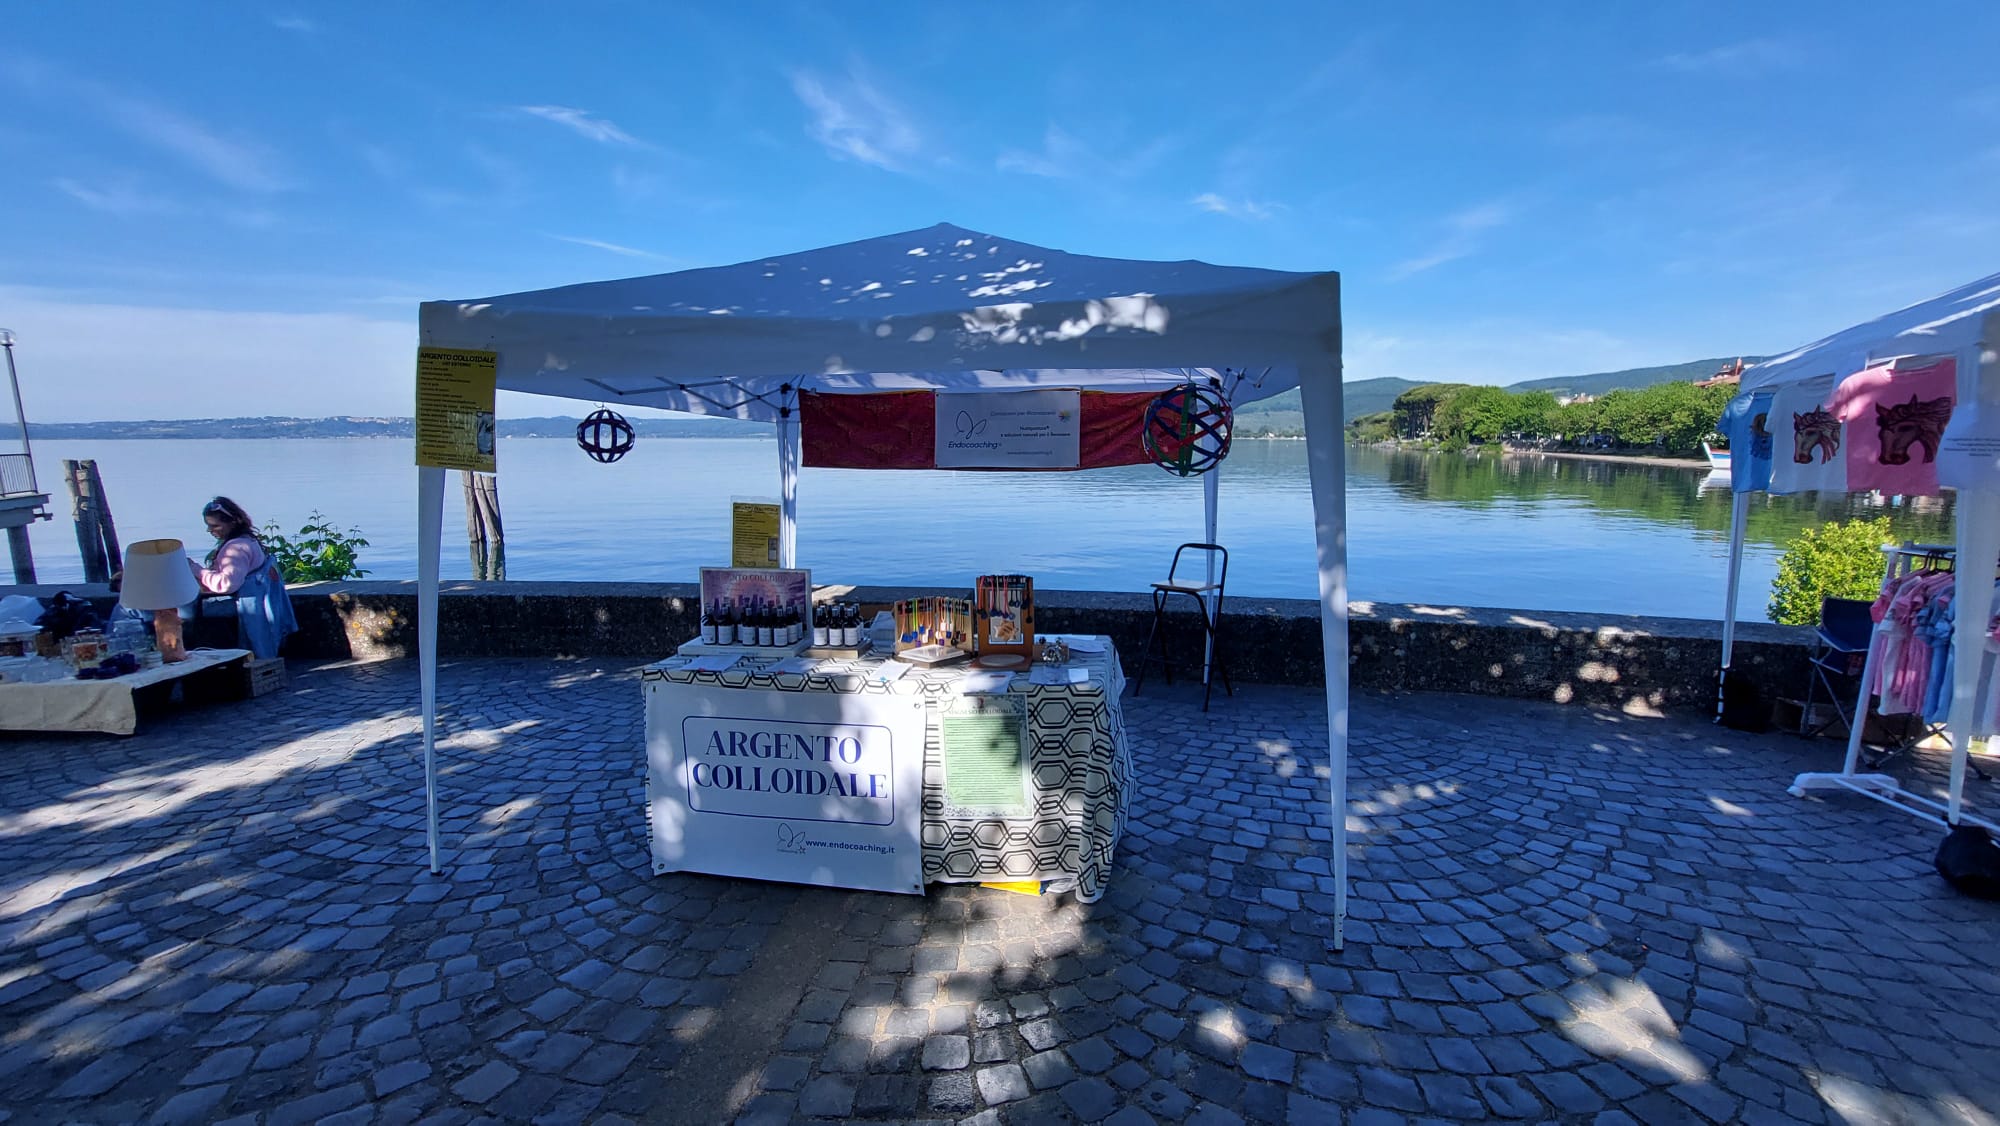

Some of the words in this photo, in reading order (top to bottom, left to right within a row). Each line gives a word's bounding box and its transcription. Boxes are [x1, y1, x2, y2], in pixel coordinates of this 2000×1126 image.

[420, 352, 452, 360] ARGENTO
[452, 354, 495, 363] COLLOIDALE
[705, 730, 862, 764] ARGENTO
[692, 762, 888, 799] COLLOIDALE
[805, 839, 895, 855] www.endocoaching.it
